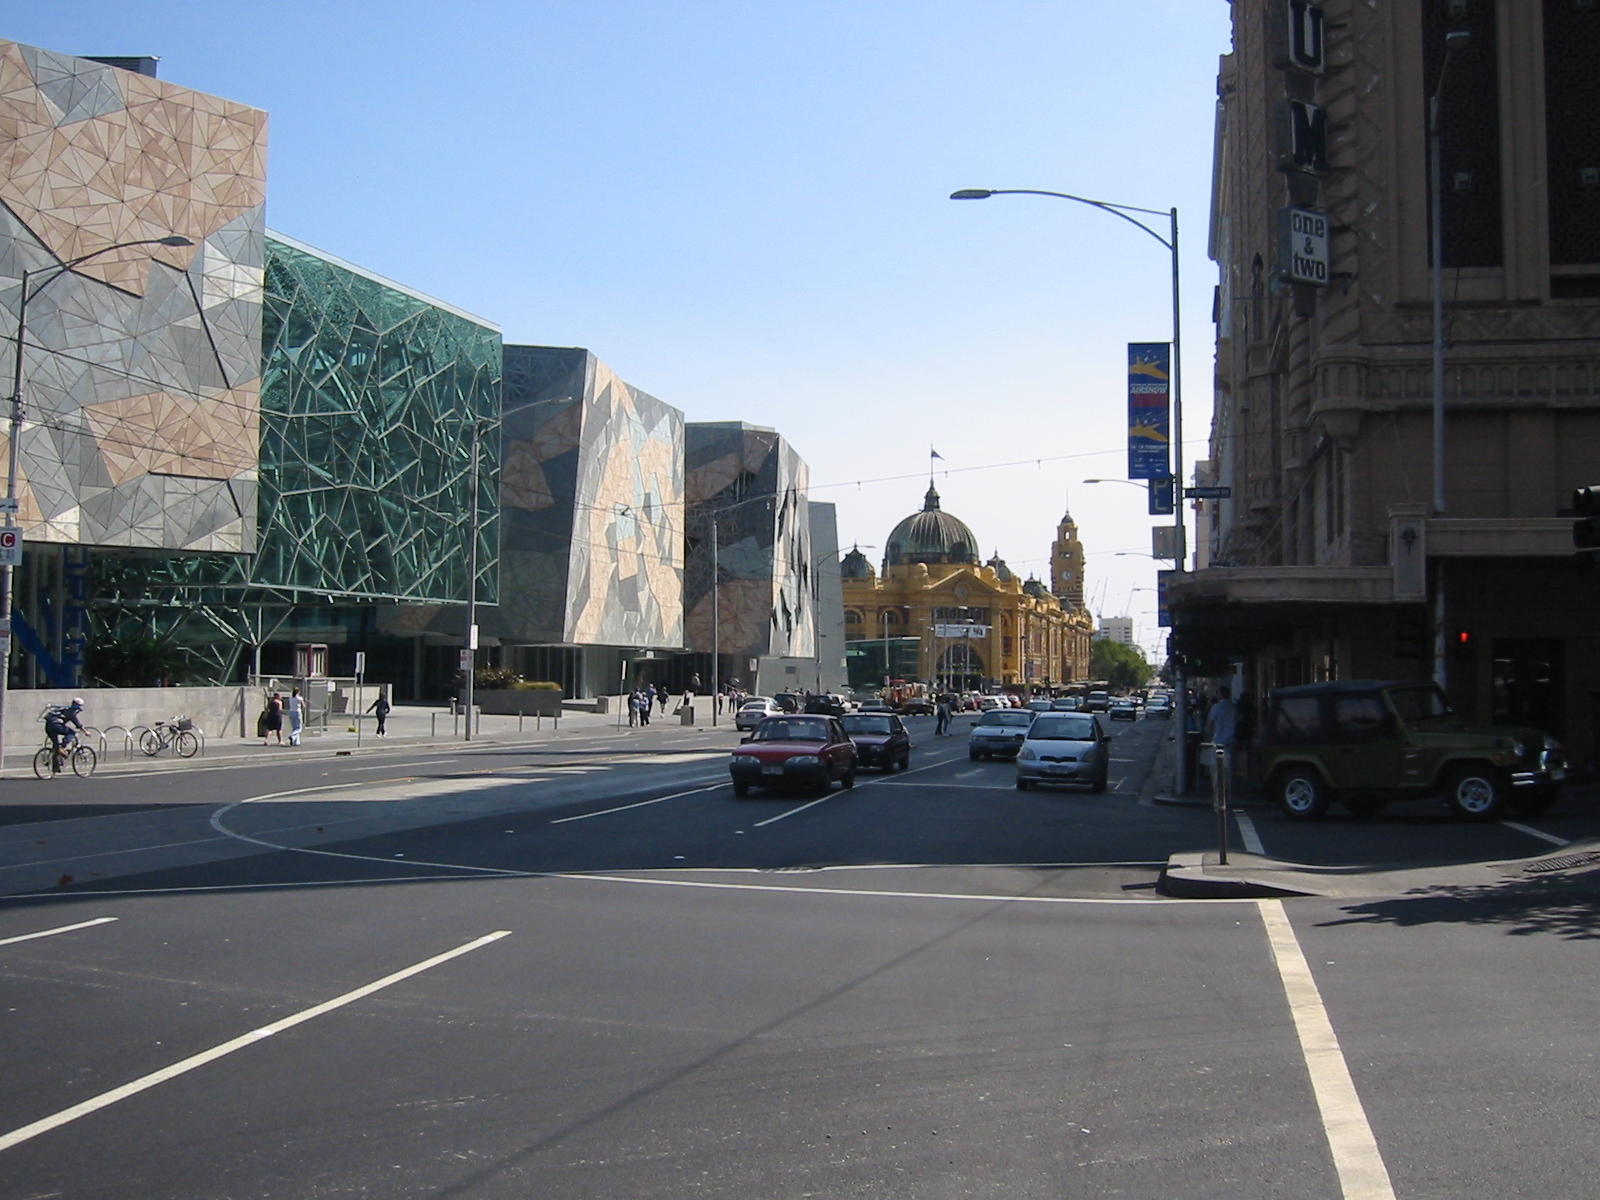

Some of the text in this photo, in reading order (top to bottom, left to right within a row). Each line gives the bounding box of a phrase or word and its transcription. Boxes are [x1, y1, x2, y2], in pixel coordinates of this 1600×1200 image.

[1293, 213, 1325, 238] one
[1303, 237, 1314, 255] &
[1294, 252, 1326, 280] two
